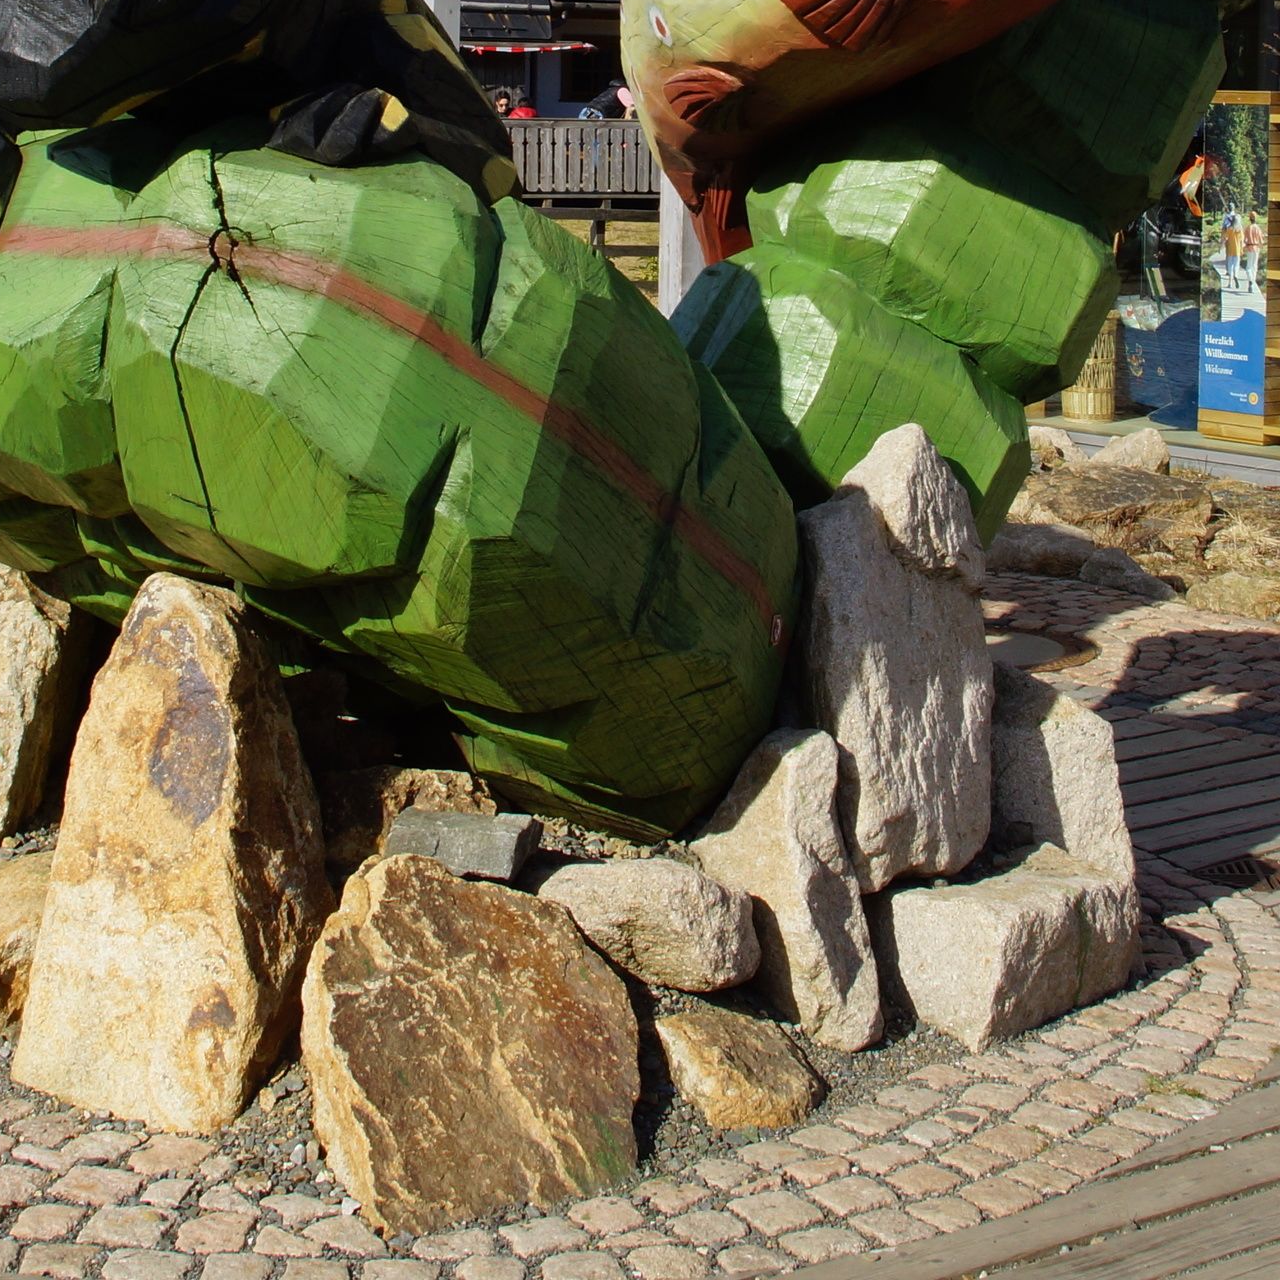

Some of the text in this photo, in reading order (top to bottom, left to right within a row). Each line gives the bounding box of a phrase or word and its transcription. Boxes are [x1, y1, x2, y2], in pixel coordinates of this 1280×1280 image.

[1204, 333, 1234, 347] Herzlich
[1204, 347, 1249, 362] Willkommen
[1204, 363, 1233, 376] Welcome
